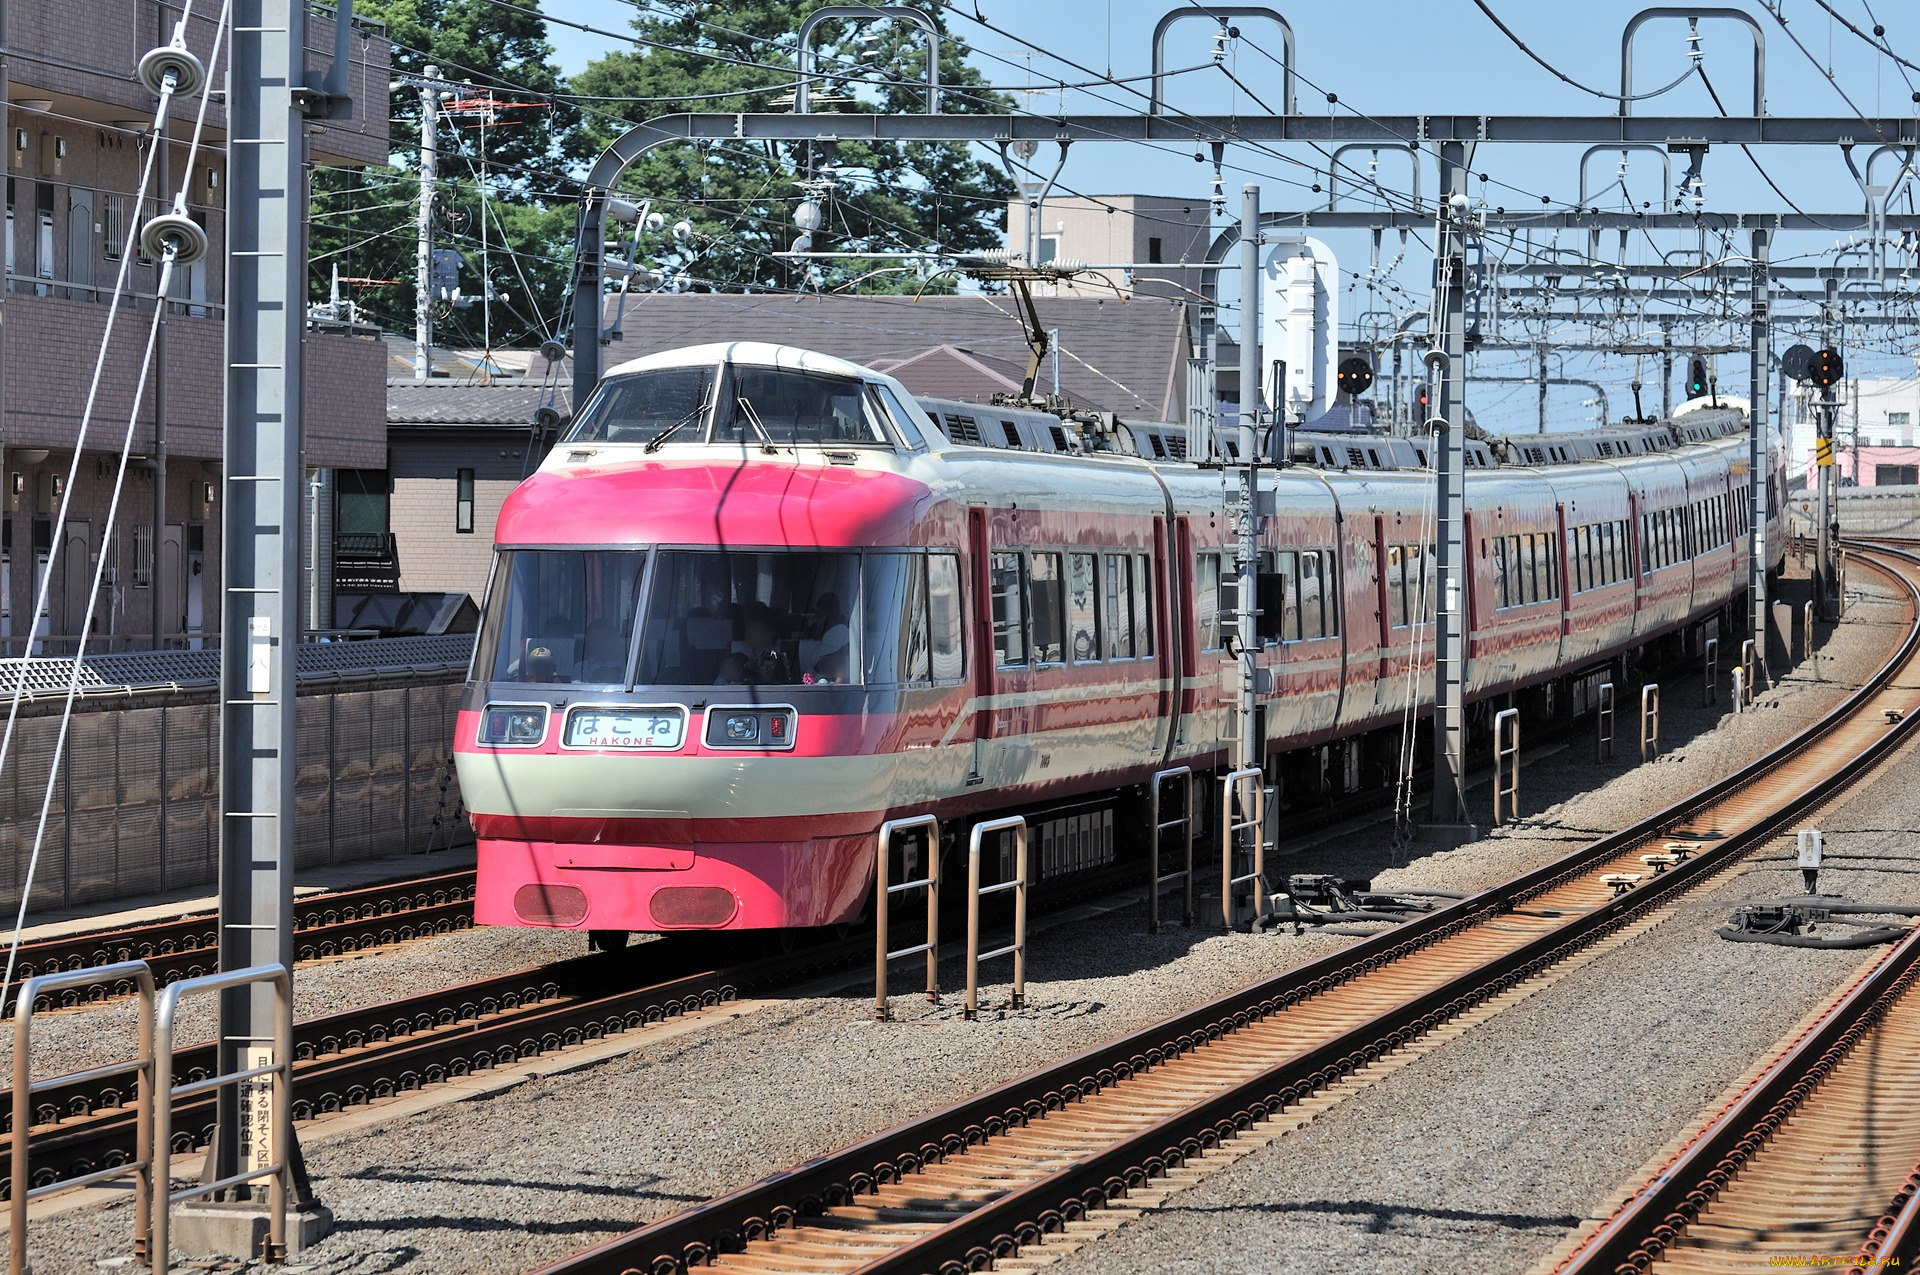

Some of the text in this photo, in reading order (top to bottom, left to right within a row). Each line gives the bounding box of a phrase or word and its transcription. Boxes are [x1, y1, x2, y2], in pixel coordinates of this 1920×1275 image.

[576, 715, 671, 735] はこね
[589, 737, 654, 746] HAKONE
